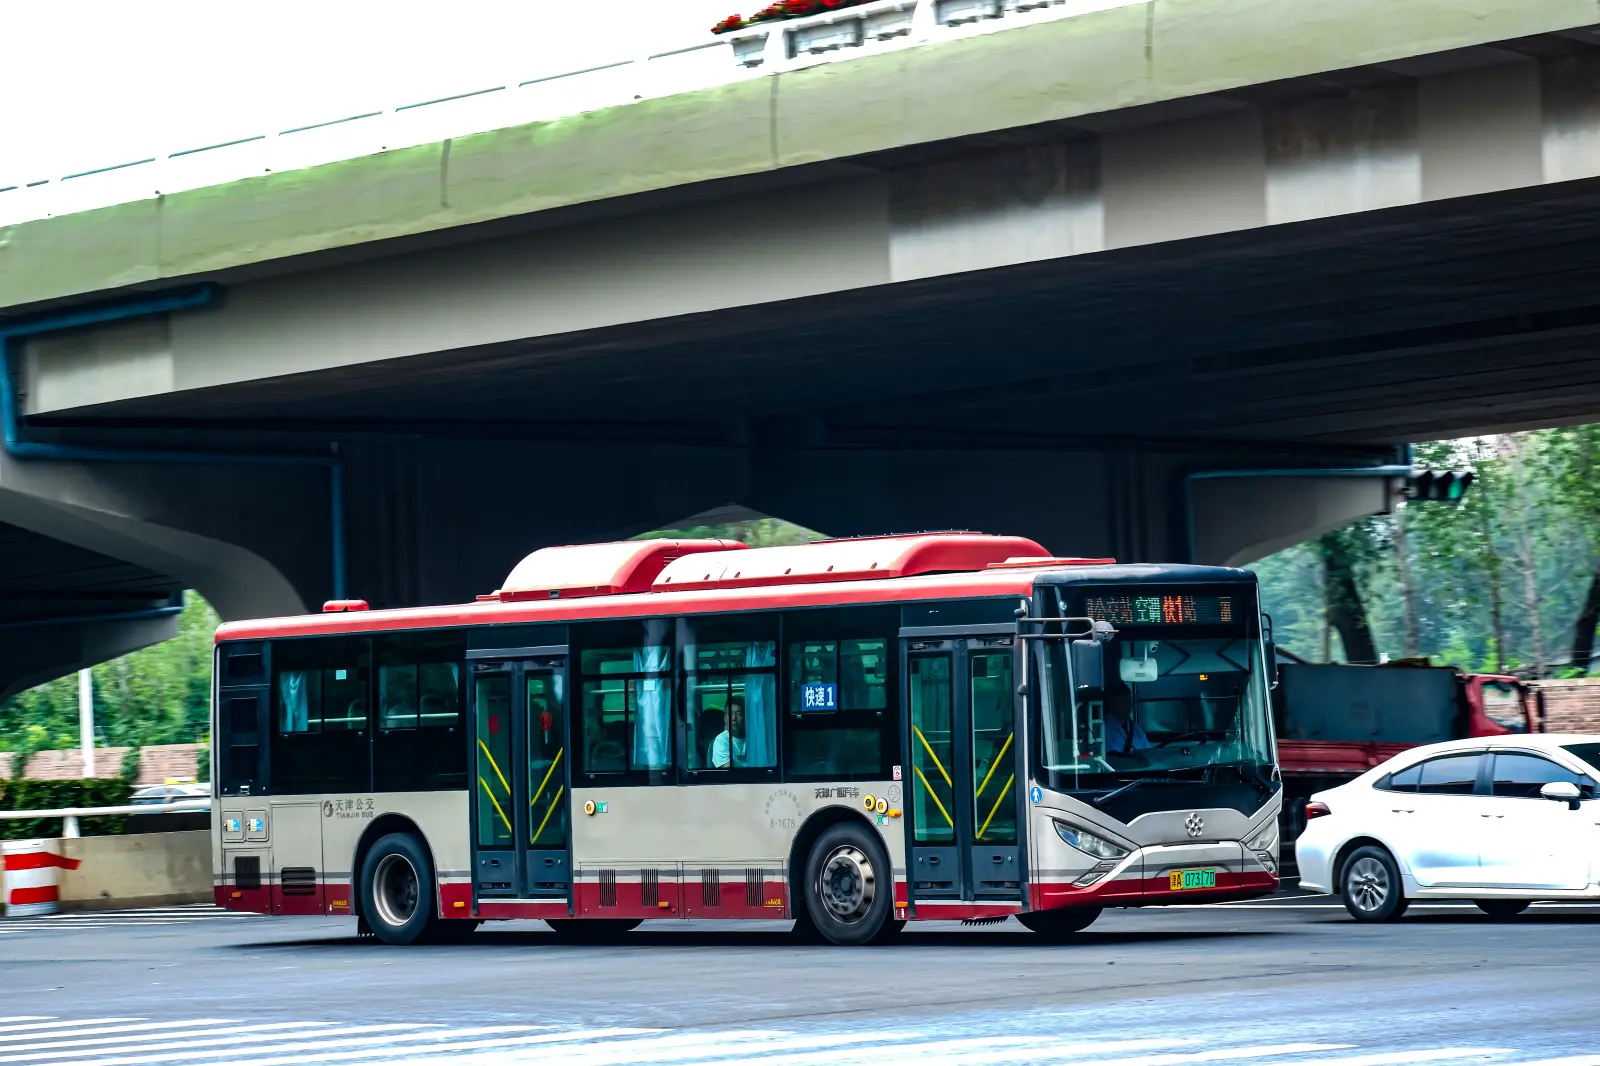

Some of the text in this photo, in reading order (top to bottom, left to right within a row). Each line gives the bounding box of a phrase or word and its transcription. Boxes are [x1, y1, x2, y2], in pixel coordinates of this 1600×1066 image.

[804, 686, 835, 708] 快速1
[335, 797, 375, 811] 天津公交
[336, 811, 360, 819] TIANJIN
[770, 818, 796, 829] 8-1678
